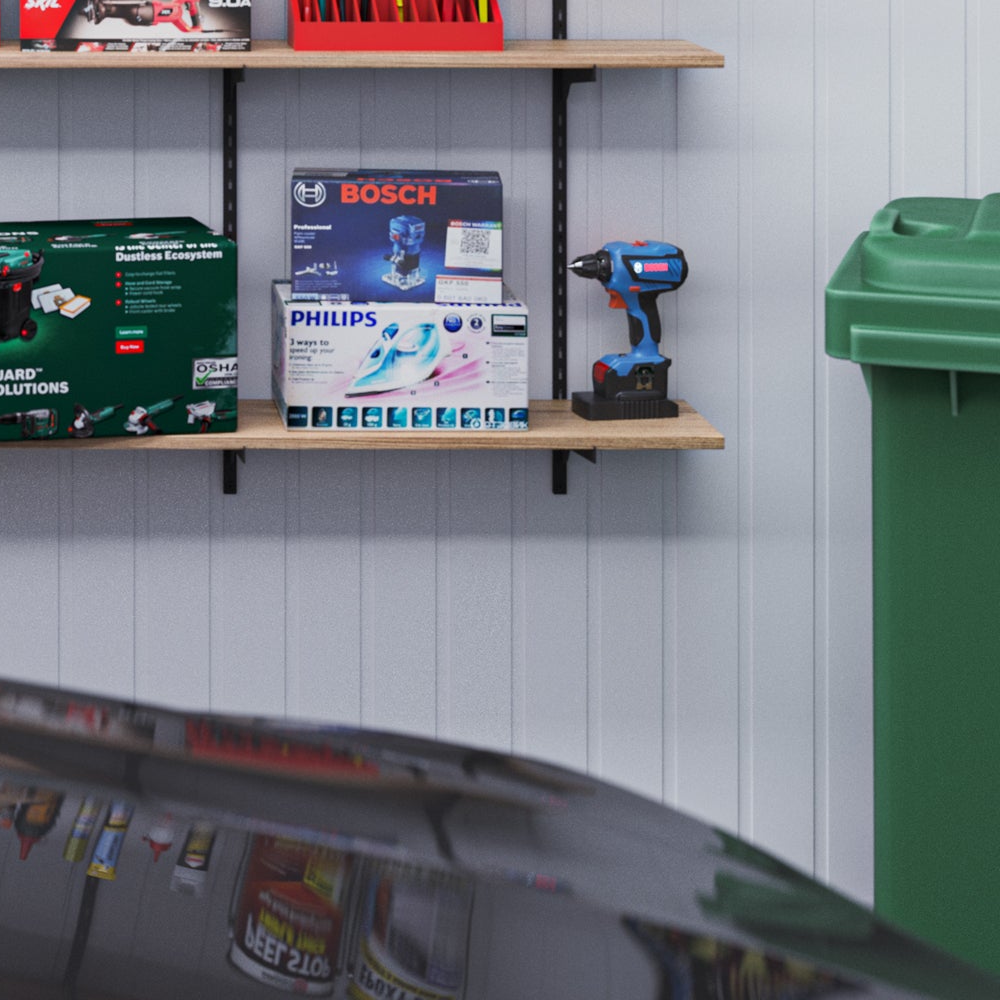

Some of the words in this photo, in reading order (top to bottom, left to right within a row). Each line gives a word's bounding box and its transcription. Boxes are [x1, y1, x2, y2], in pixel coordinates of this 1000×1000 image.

[340, 184, 438, 206] BOSCH
[116, 252, 163, 262] Dustless
[165, 250, 223, 262] Ecosystem
[291, 311, 377, 327] PHILIPS
[197, 363, 238, 373] OSHA
